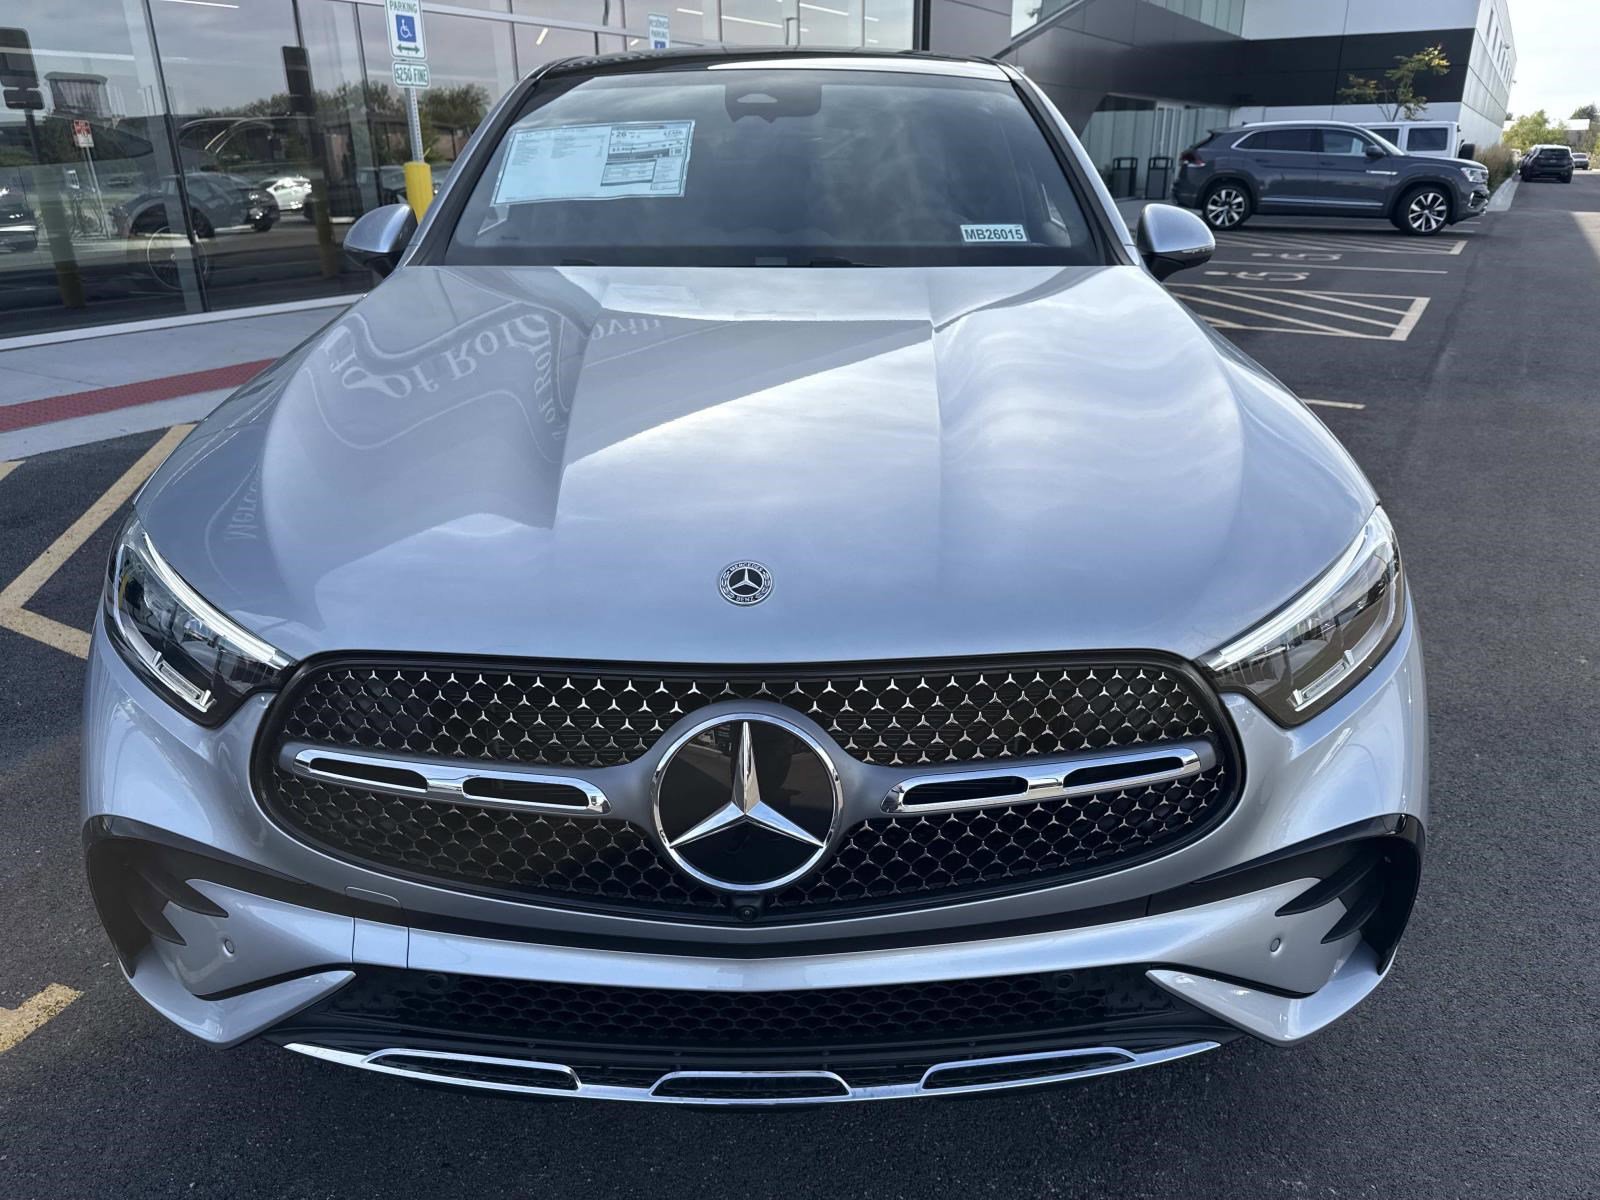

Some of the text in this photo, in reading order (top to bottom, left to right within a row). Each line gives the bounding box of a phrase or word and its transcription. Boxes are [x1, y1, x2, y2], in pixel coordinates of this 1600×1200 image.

[390, 0, 418, 13] PARKING
[395, 67, 427, 83] $250 FINE
[964, 229, 1024, 240] MB26015
